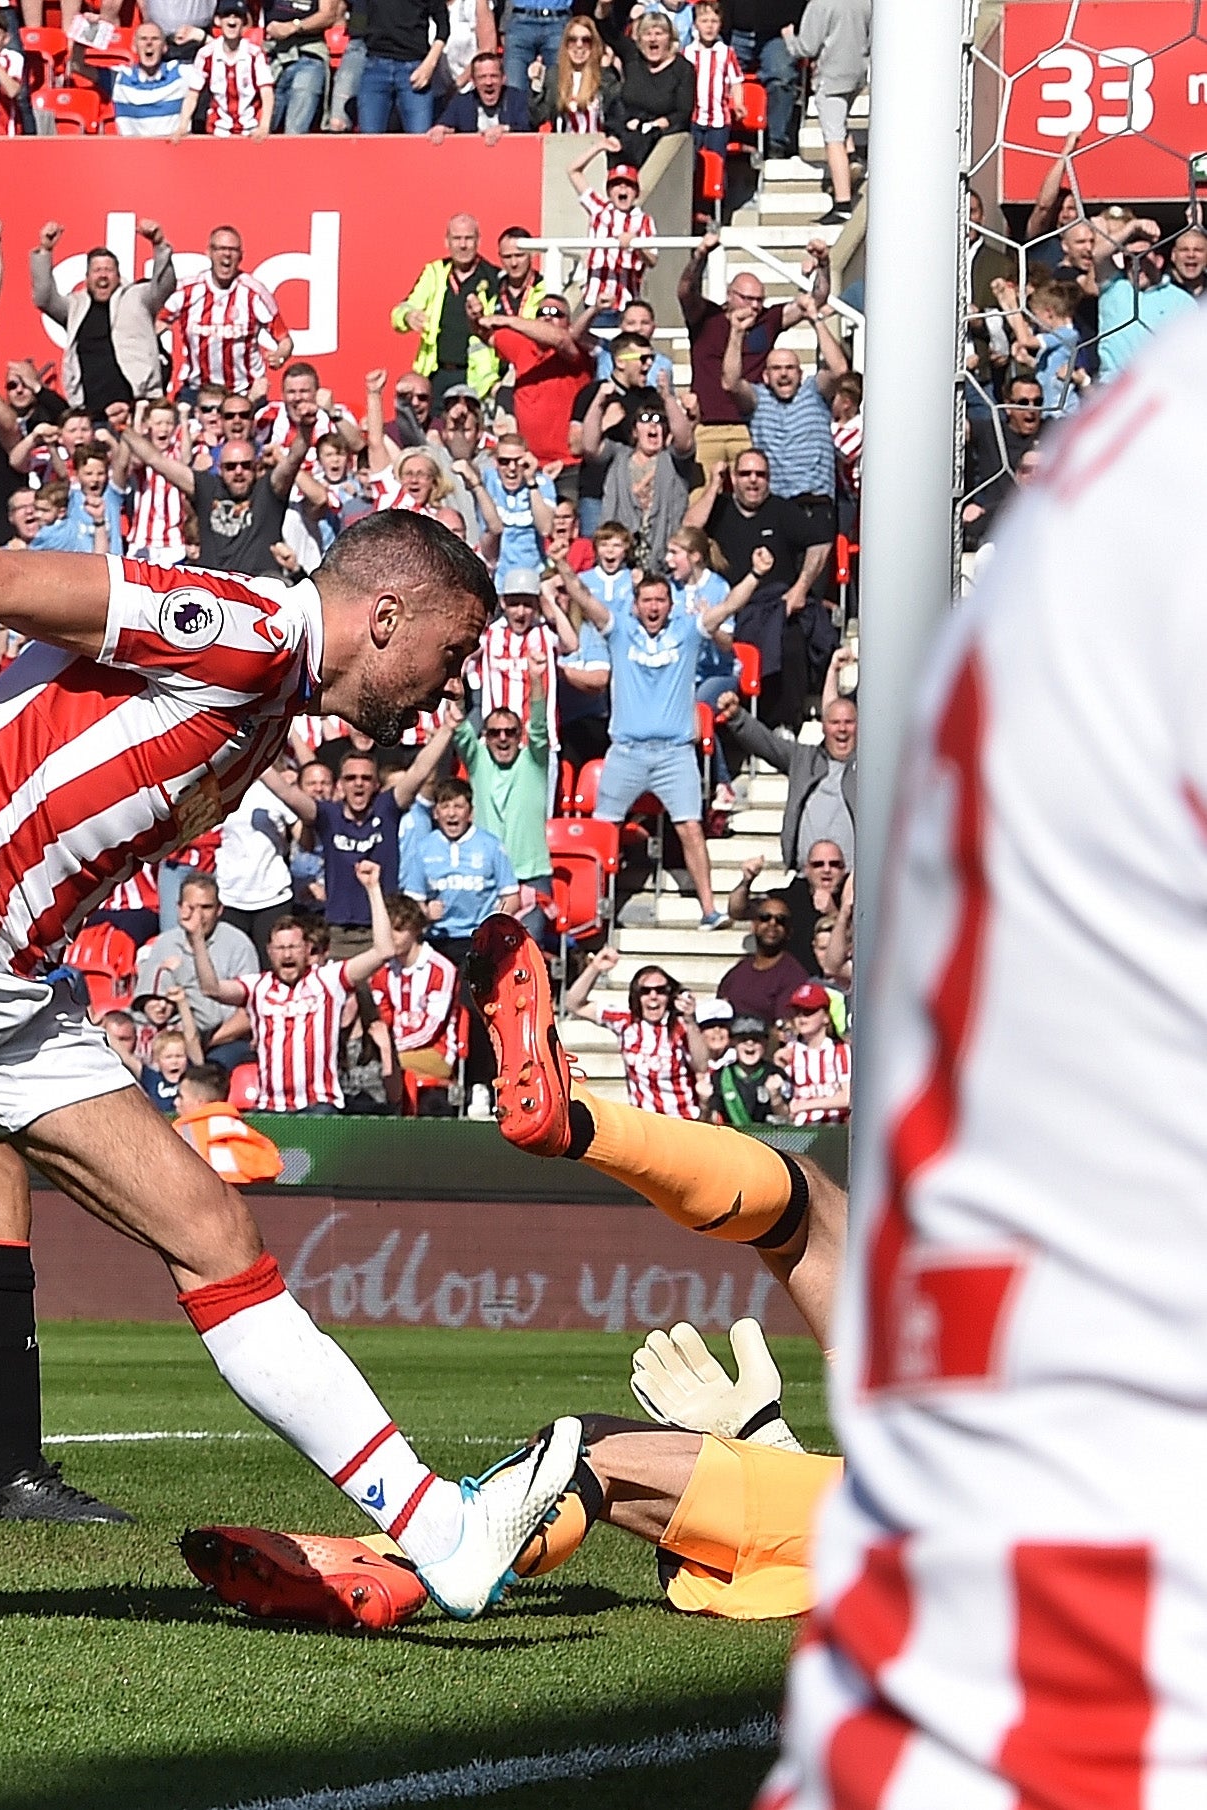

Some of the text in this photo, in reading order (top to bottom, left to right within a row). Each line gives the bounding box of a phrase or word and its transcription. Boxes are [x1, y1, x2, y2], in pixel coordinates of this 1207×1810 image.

[1037, 47, 1155, 138] 33
[285, 1212, 783, 1334] follow your
